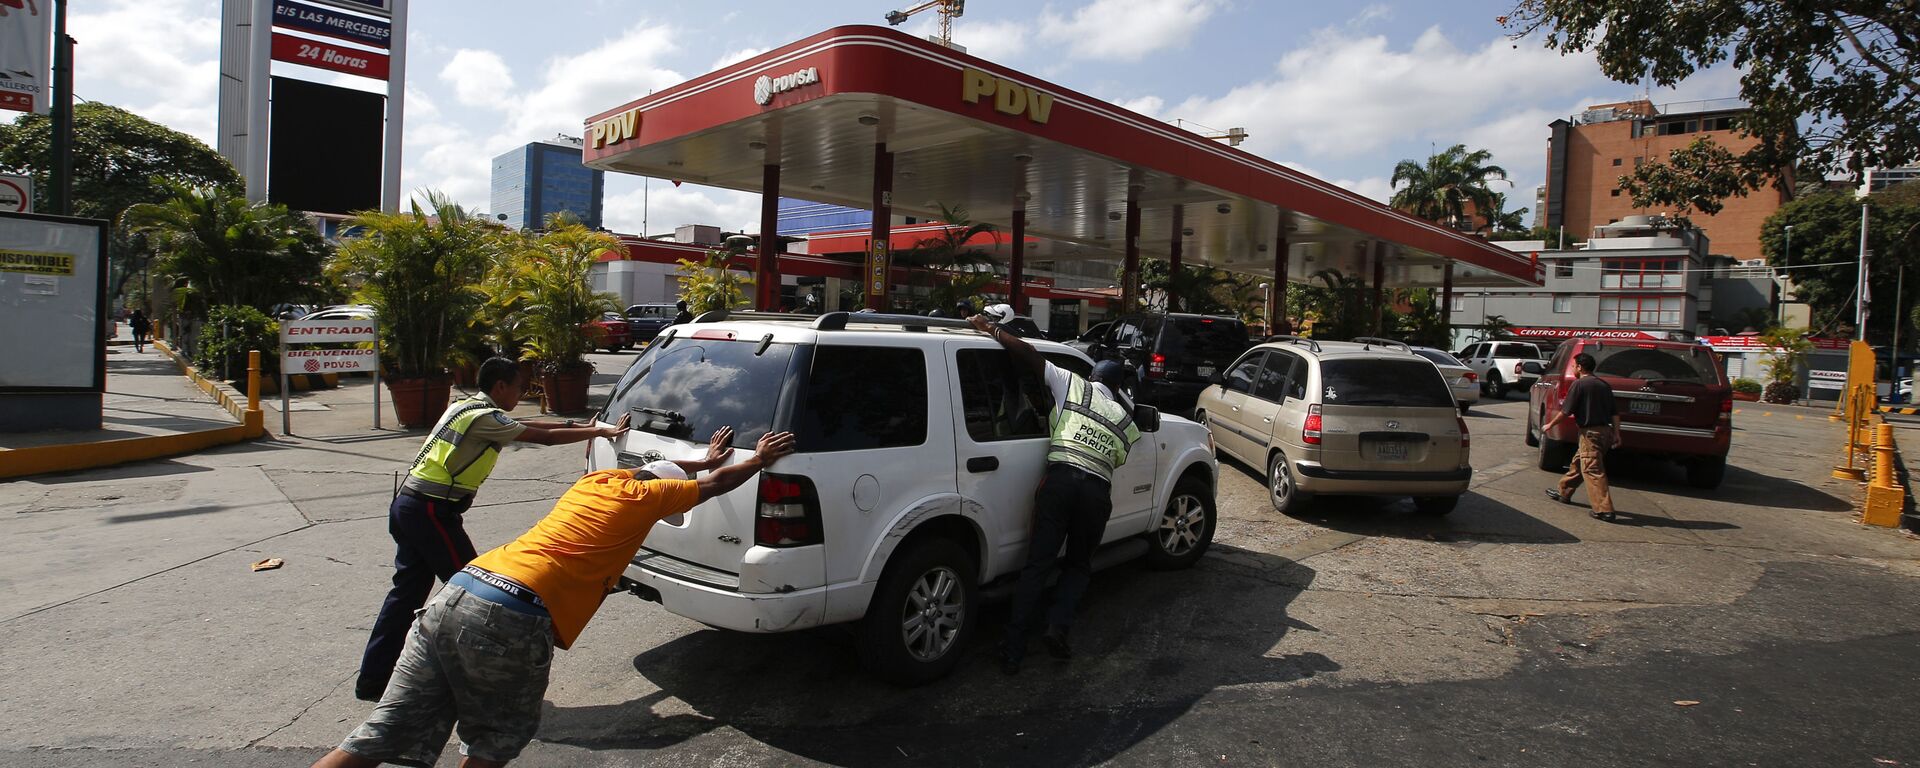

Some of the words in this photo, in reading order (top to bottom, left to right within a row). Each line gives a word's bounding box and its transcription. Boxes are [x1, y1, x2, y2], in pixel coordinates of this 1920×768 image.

[276, 5, 296, 17] E/S
[299, 10, 324, 23] LAS
[326, 16, 390, 38] MERCEDES
[297, 44, 320, 60] 24
[322, 49, 368, 69] Horas
[772, 66, 819, 93] PDVSA
[962, 67, 1055, 125] PDV
[592, 108, 641, 149] PDV
[0, 252, 70, 268] ISPONIBLE
[288, 326, 374, 336] ENTRADA
[1520, 329, 1556, 337] CENTRO
[287, 349, 374, 358] BIENVENIDO
[323, 361, 360, 369] PDVSA
[1073, 432, 1112, 459] BARUTA
